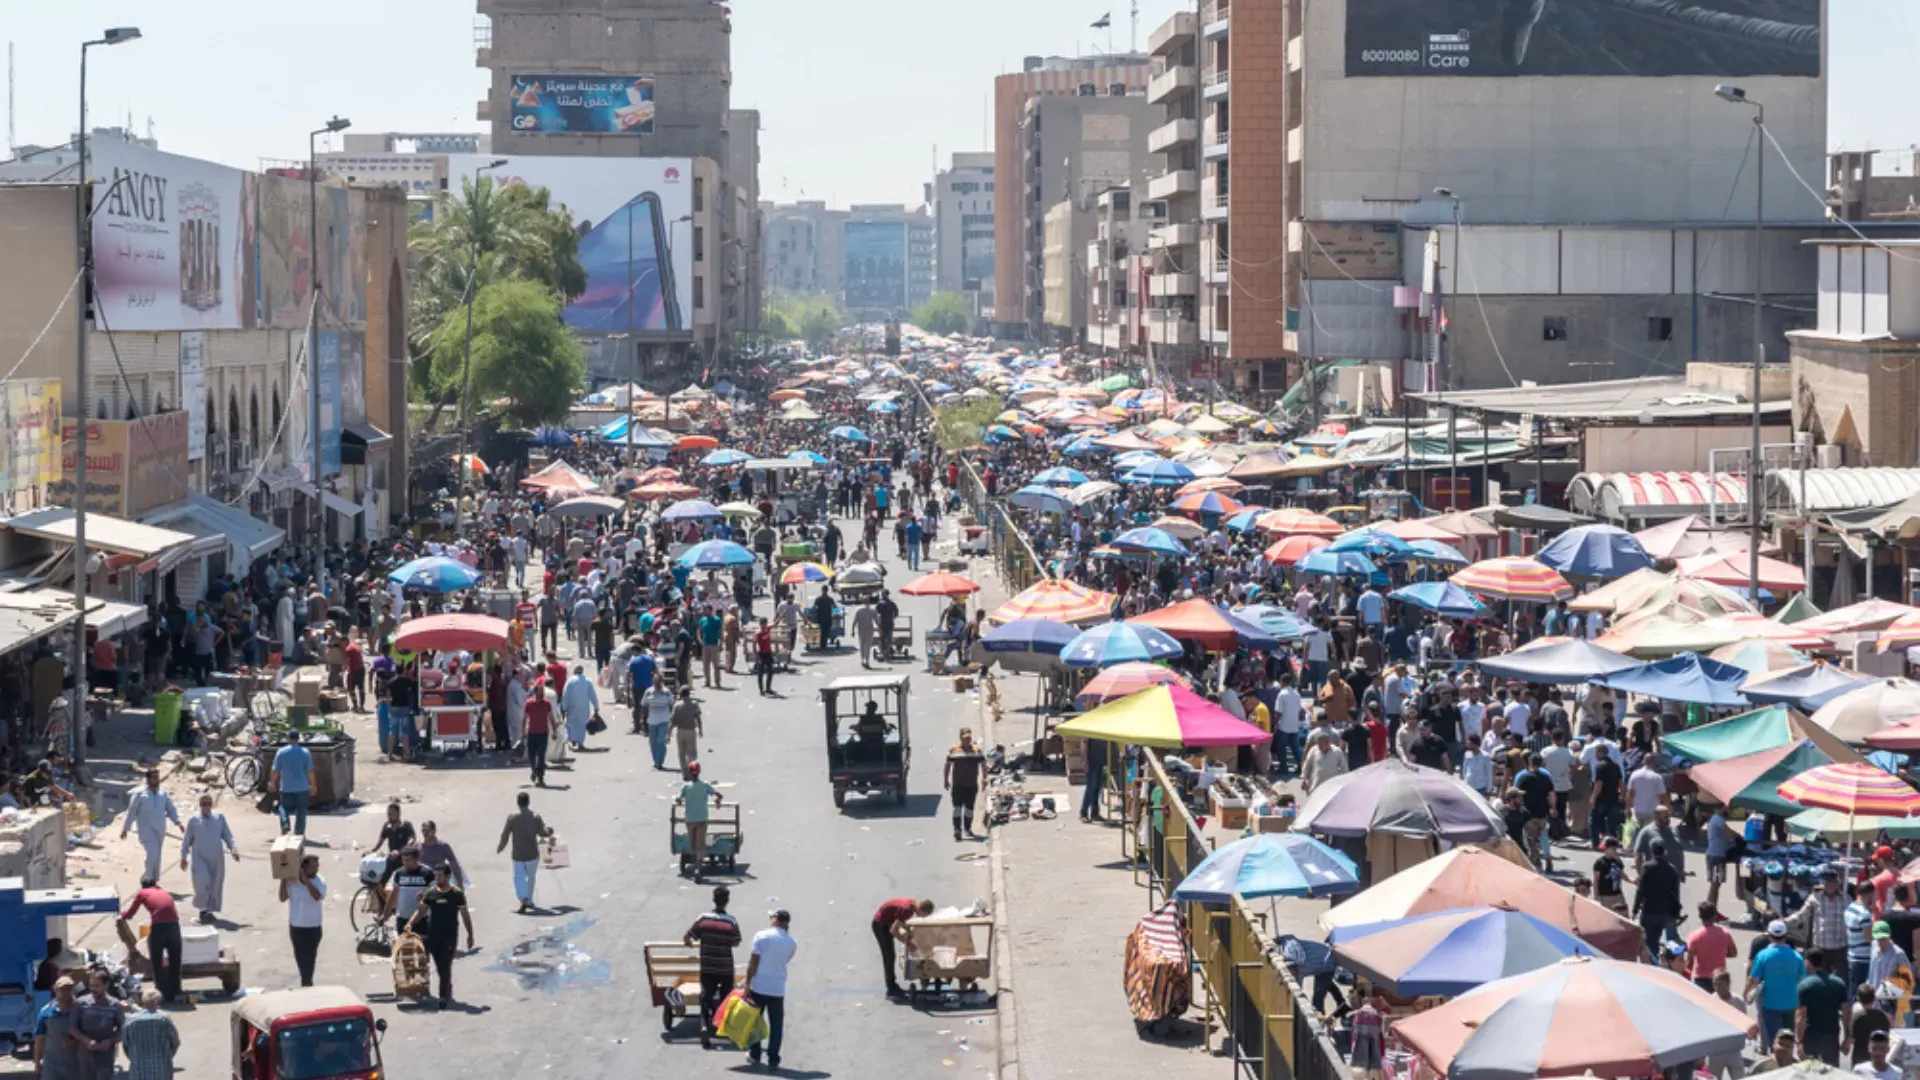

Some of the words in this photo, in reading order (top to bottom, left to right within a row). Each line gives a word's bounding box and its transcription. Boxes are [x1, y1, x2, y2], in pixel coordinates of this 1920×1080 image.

[1361, 49, 1420, 62] 80010080
[1428, 54, 1470, 68] Care
[610, 80, 625, 93] مع
[107, 166, 168, 223] ANGY
